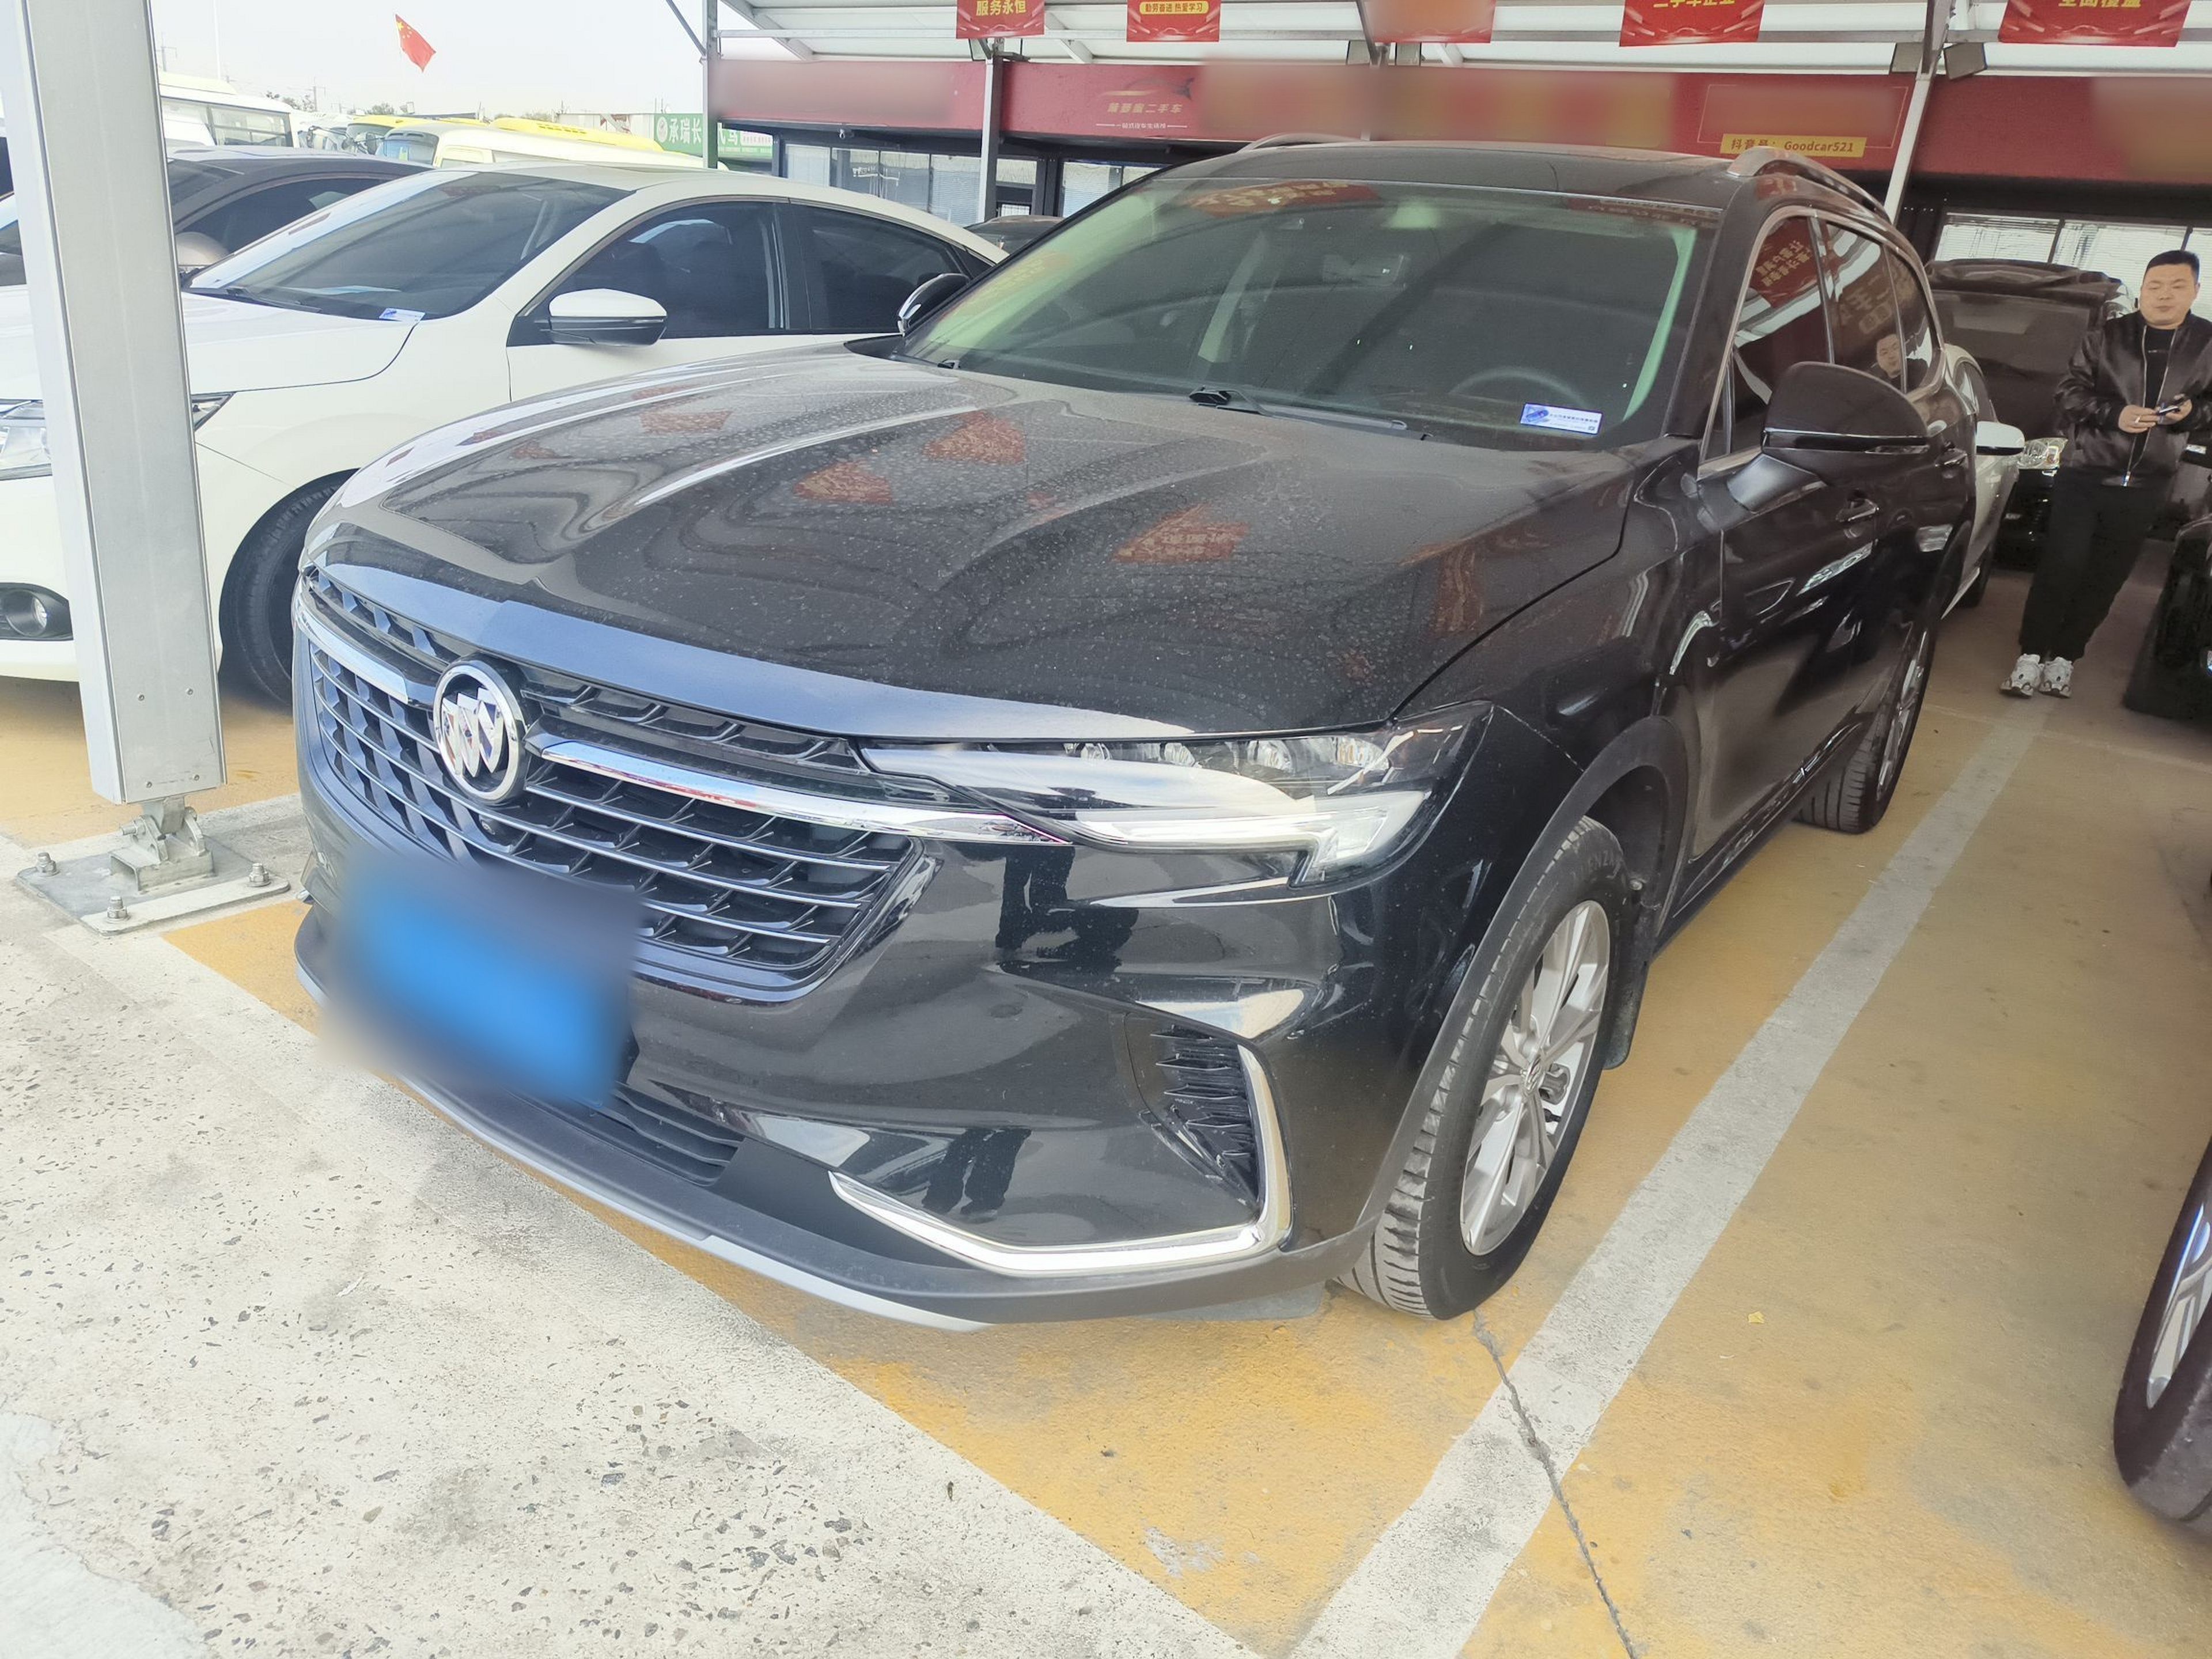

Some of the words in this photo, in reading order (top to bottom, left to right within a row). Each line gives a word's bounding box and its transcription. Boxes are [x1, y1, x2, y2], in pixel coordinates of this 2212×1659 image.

[976, 0, 1027, 16] 服务永恒
[1175, 2, 1203, 12] 热爱学习
[1784, 141, 1853, 152] Goodcar521
